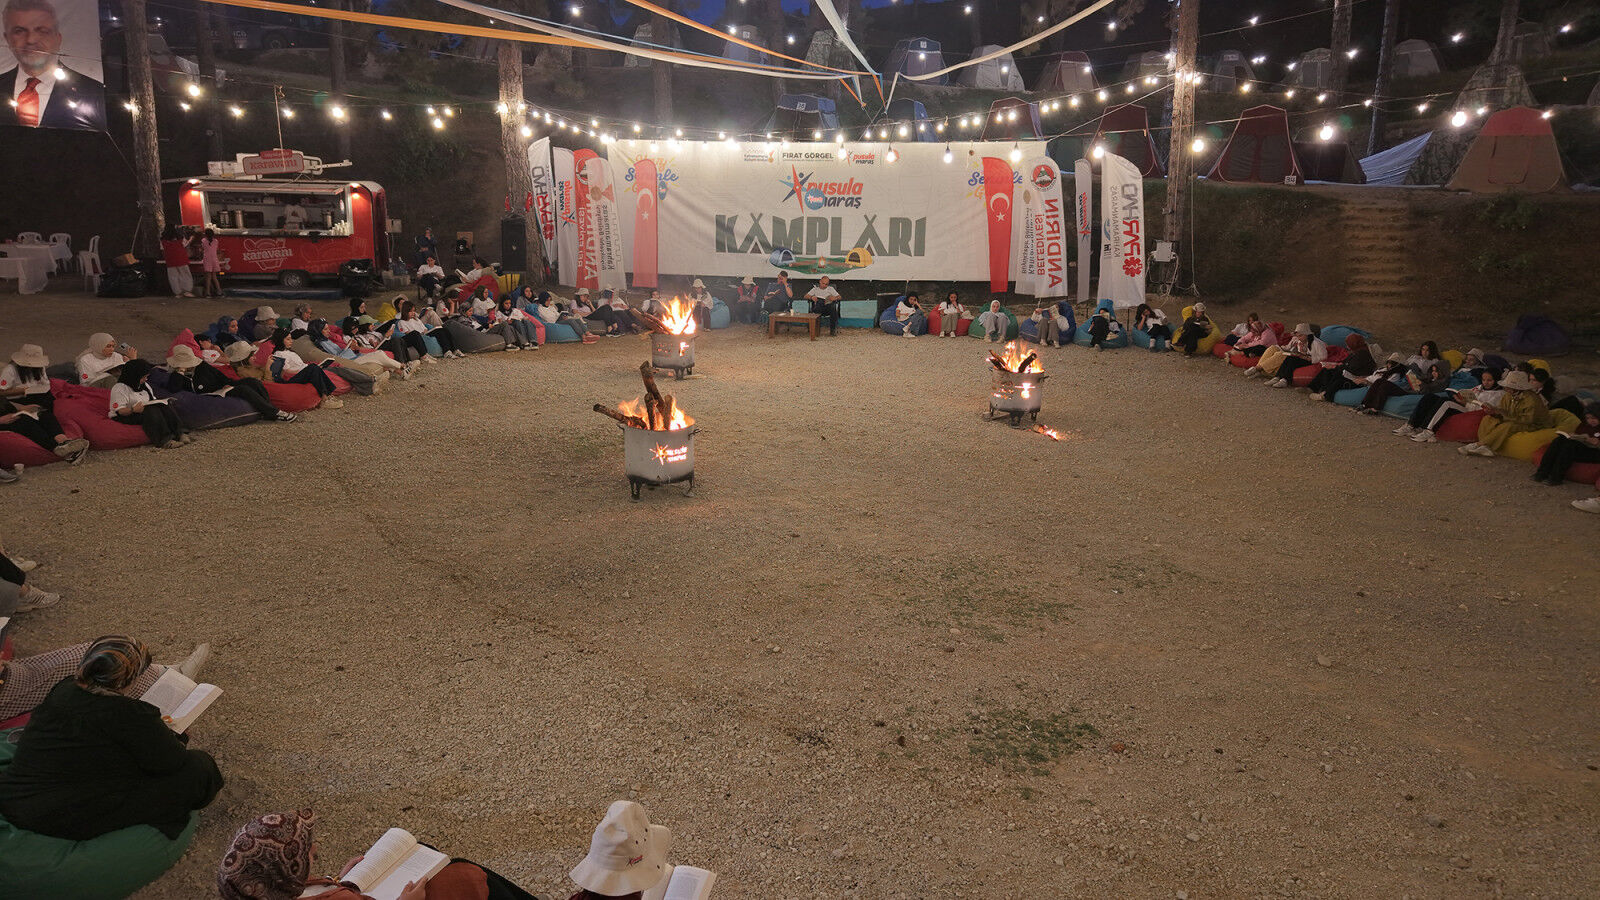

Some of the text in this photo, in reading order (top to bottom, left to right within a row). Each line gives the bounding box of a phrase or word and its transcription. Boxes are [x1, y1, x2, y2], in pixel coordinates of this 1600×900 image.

[853, 152, 875, 161] pusula
[625, 167, 679, 182] Snle
[968, 171, 1023, 186] Sele
[823, 196, 862, 209] araş
[715, 212, 927, 257] KAMPLARI
